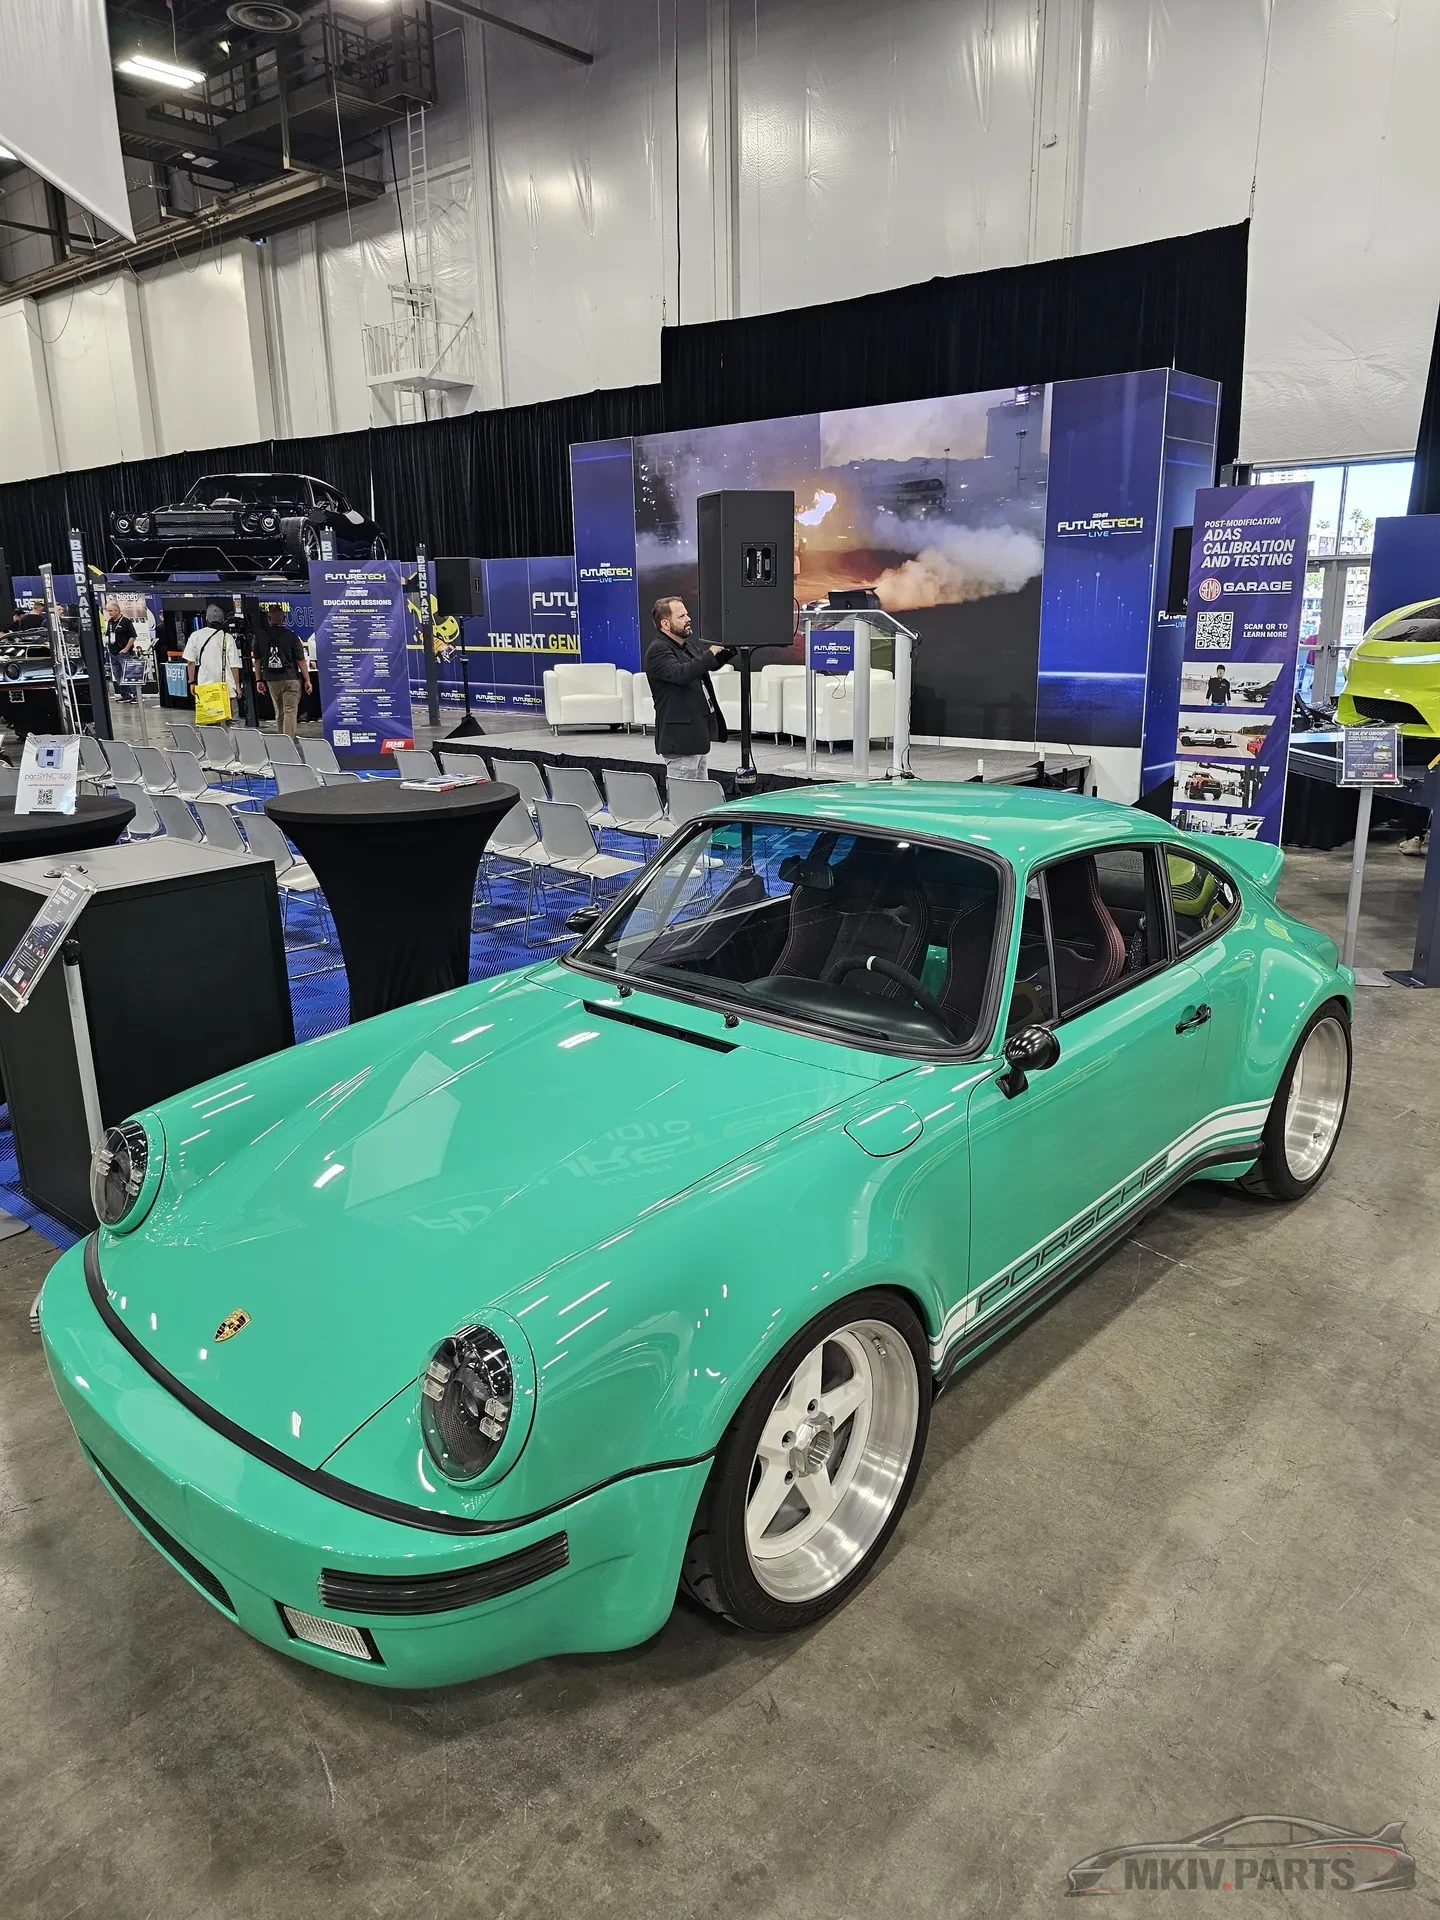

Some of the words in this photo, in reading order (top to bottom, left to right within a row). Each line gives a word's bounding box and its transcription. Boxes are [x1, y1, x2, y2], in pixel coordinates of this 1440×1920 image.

[1057, 517, 1144, 532] FUTURETECH
[1204, 517, 1281, 528] POST-MODIFICATION
[1203, 527, 1242, 541] ADAS
[1203, 539, 1295, 555] CALIBRATION
[1201, 555, 1231, 569] AND
[1234, 553, 1293, 567] TESTING
[69, 539, 91, 618] BENDPAK
[580, 567, 632, 578] FUTURETECH
[417, 555, 429, 615] BENDPAK
[1223, 581, 1292, 592] GARAGE
[487, 632, 512, 648] THE
[515, 633, 545, 649] NEXT
[977, 1152, 1169, 1313] PORSCHE
